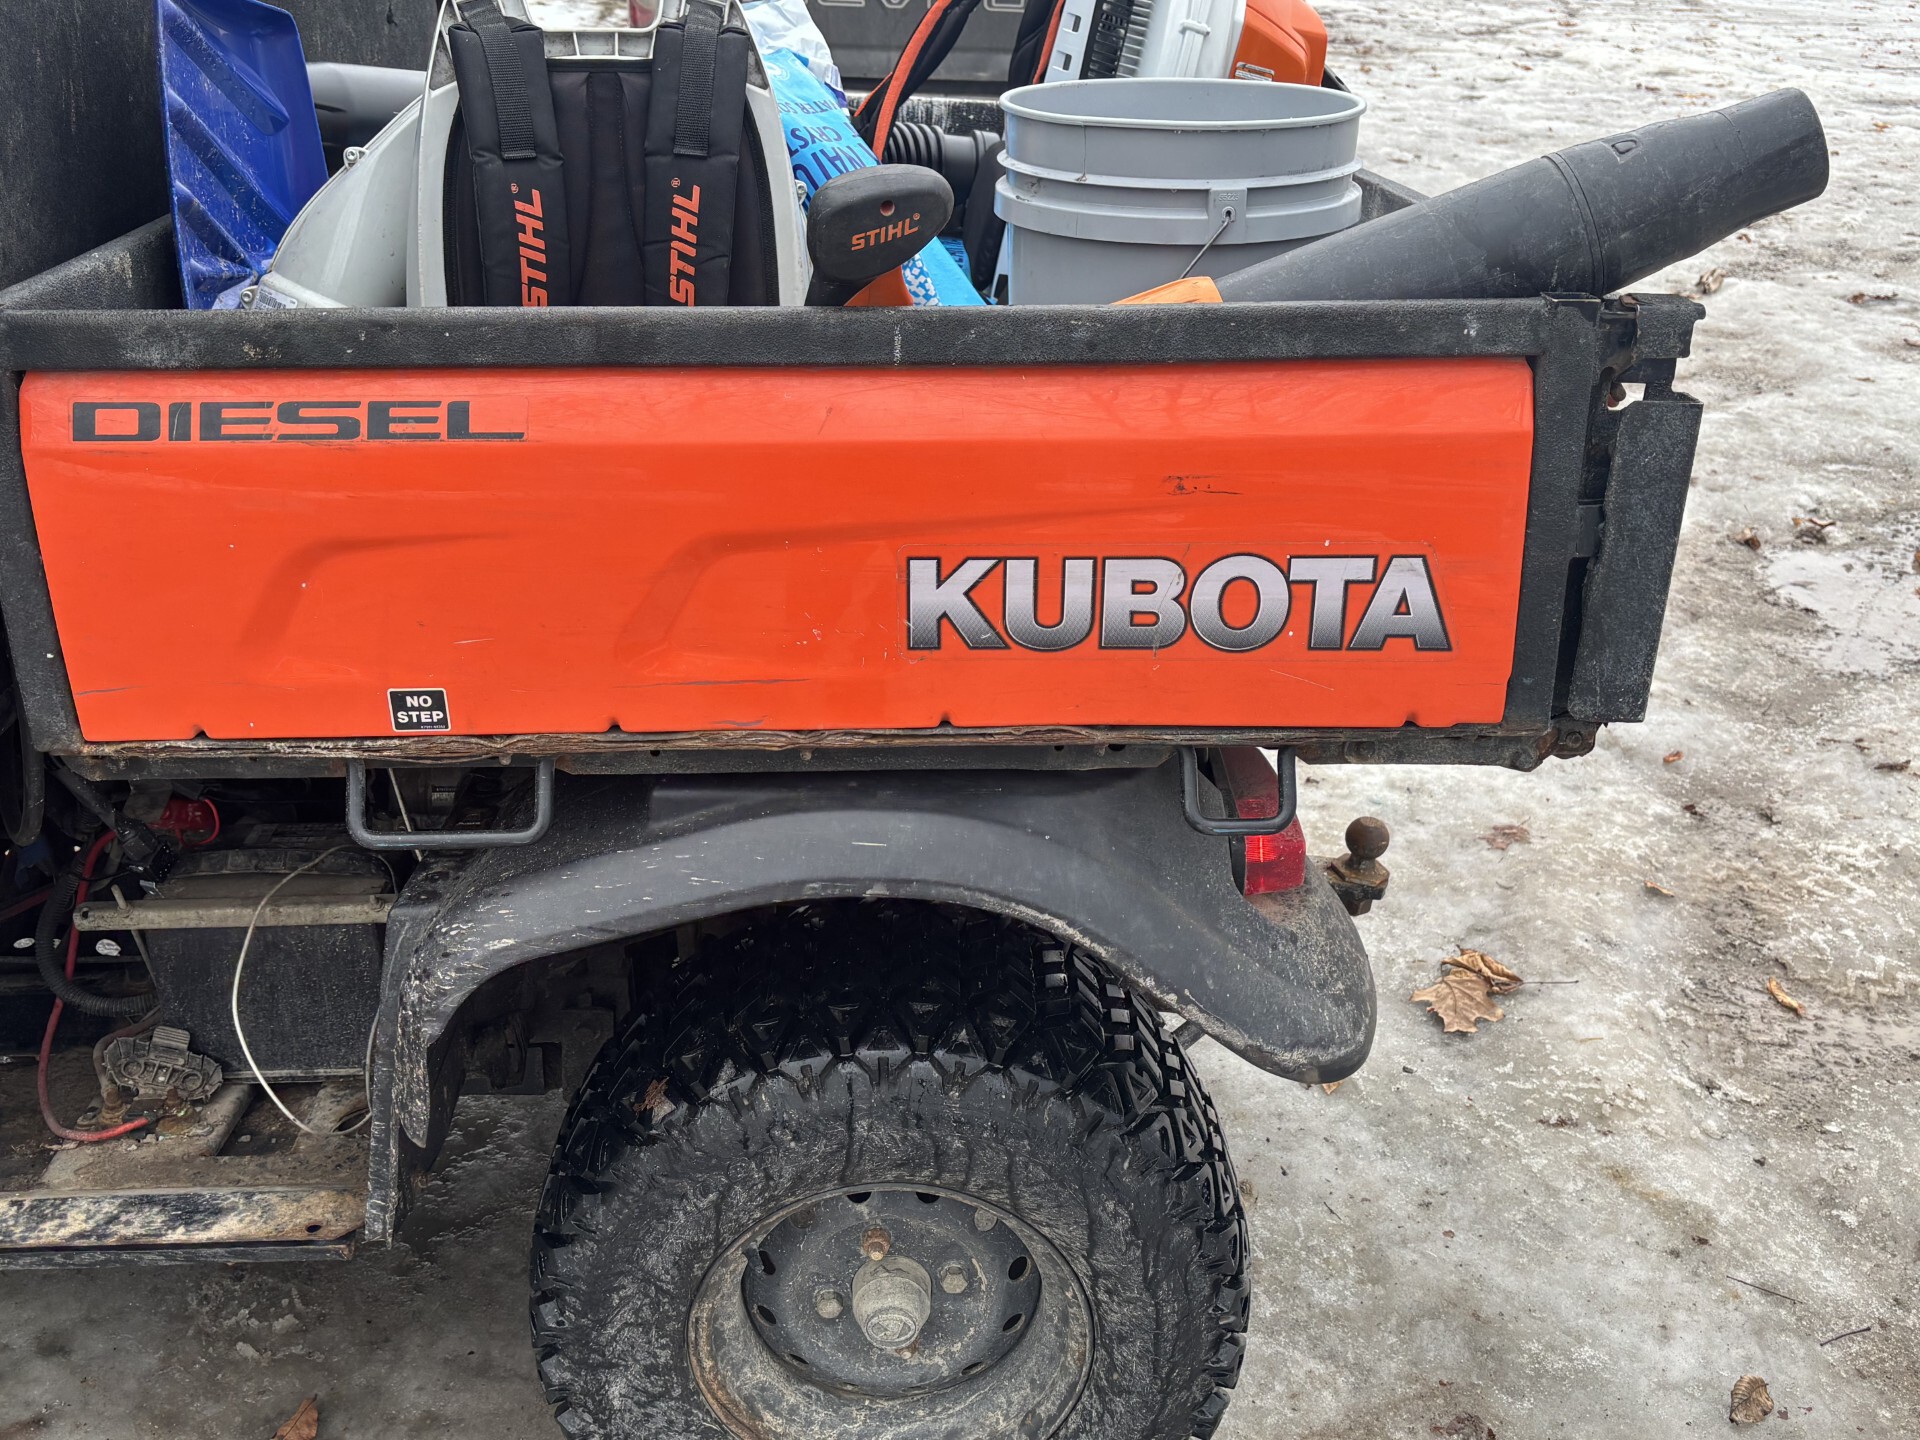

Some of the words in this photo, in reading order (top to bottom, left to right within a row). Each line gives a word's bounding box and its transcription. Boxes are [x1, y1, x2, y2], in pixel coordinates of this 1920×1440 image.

[514, 188, 548, 307] STIHL
[669, 184, 701, 307] STIHL
[851, 217, 920, 251] STIHL
[72, 400, 525, 442] DIESEL
[906, 554, 1453, 651] KUBOTA
[397, 711, 444, 723] STEP
[405, 695, 433, 708] NO
